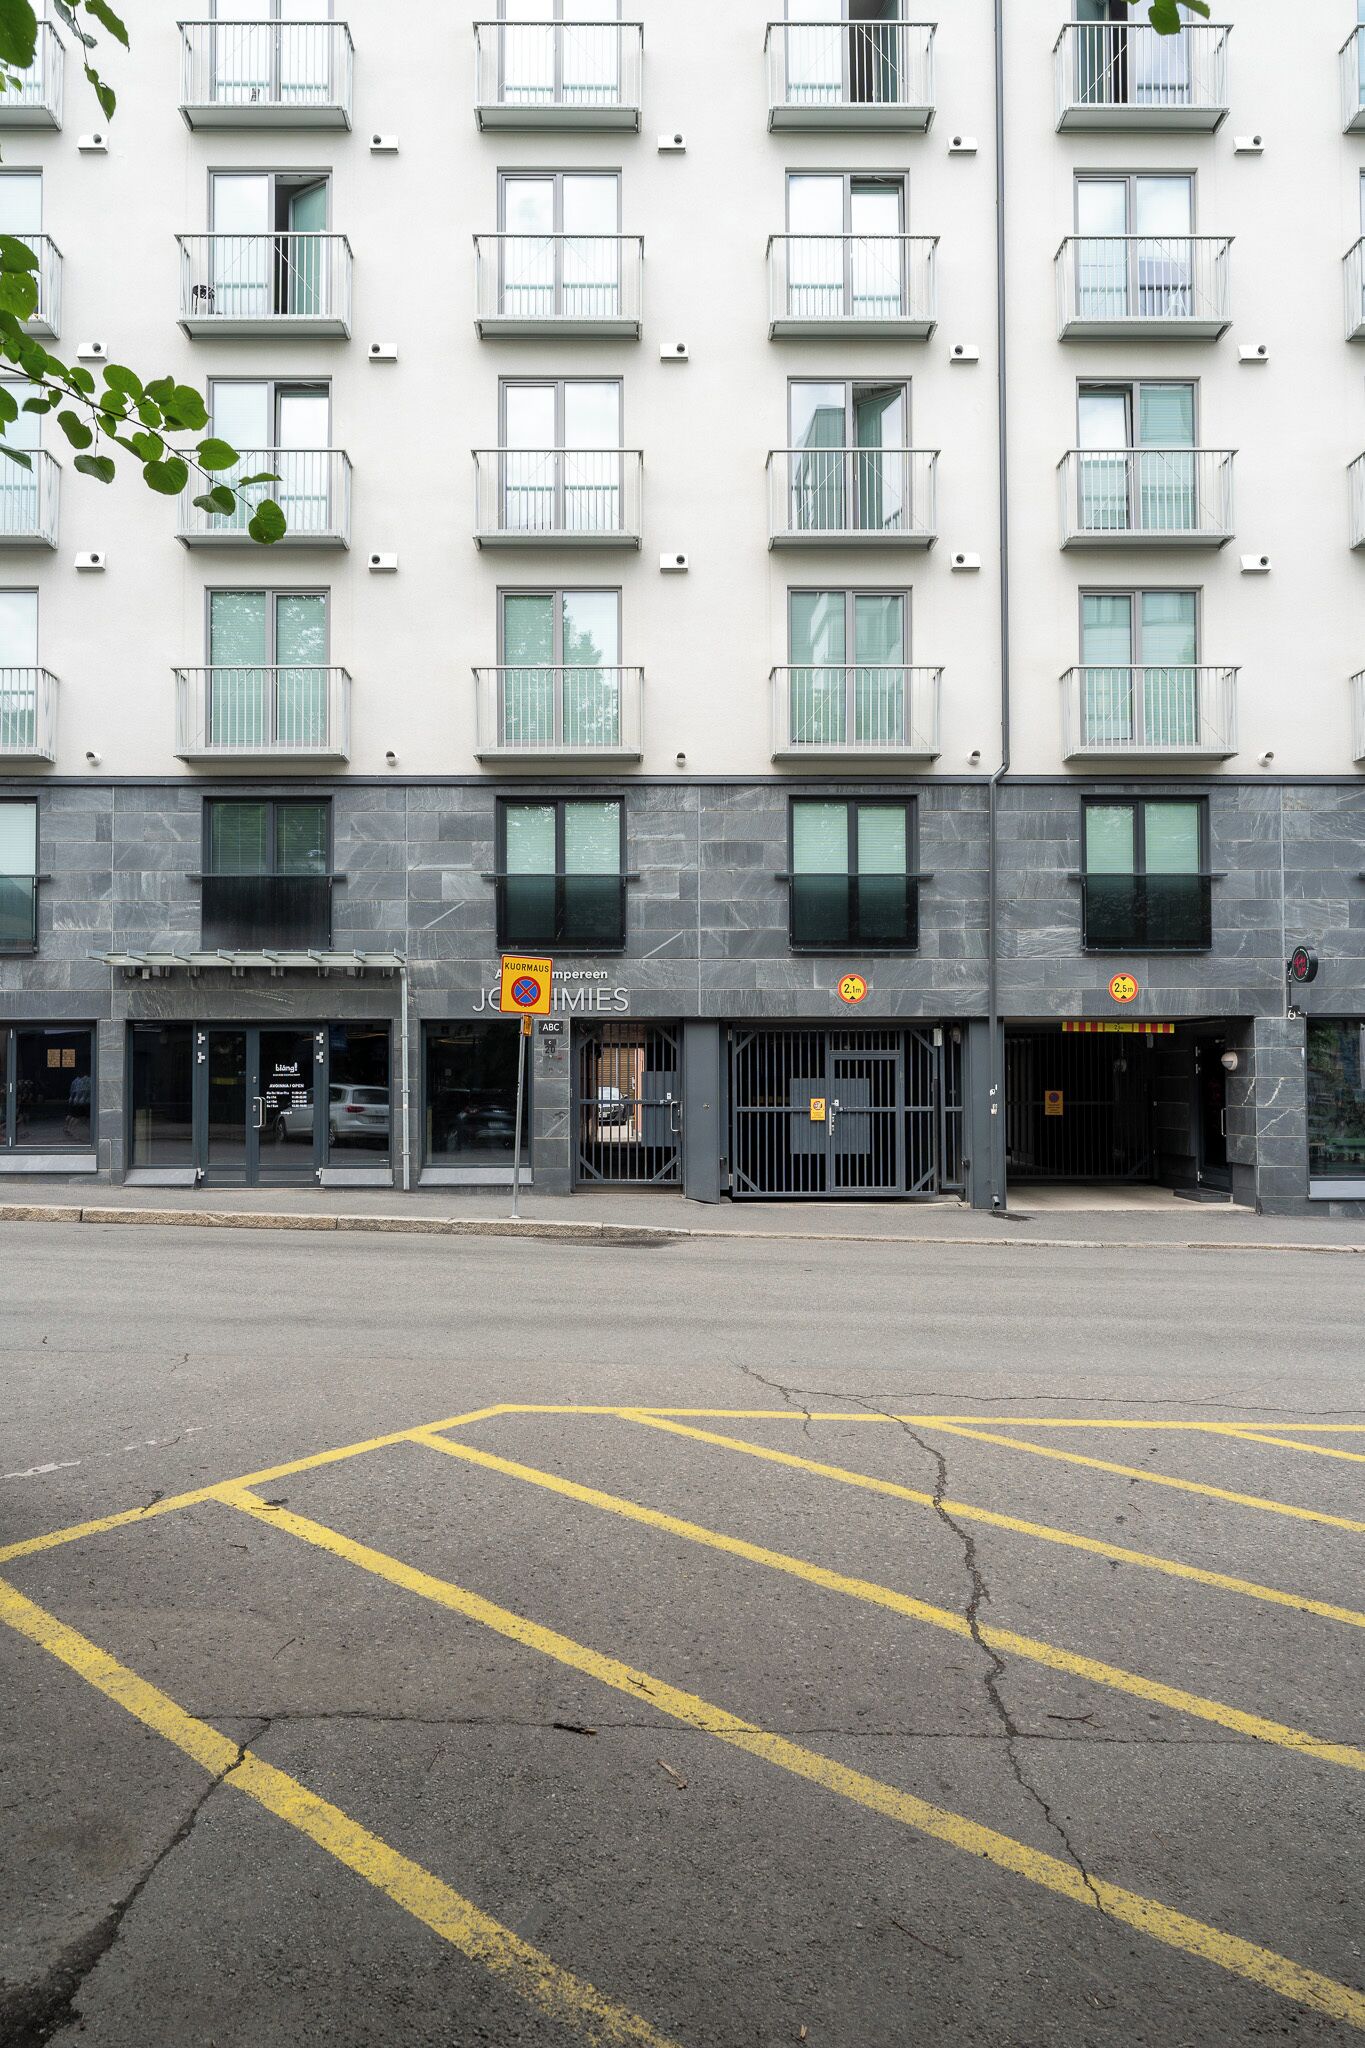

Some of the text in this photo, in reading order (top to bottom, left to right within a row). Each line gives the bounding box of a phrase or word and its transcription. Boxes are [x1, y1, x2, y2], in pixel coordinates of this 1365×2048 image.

[504, 962, 550, 973] KUORMAUS
[552, 970, 608, 981] mpereen
[542, 1023, 560, 1032] ABC
[544, 1045, 556, 1054] 20
